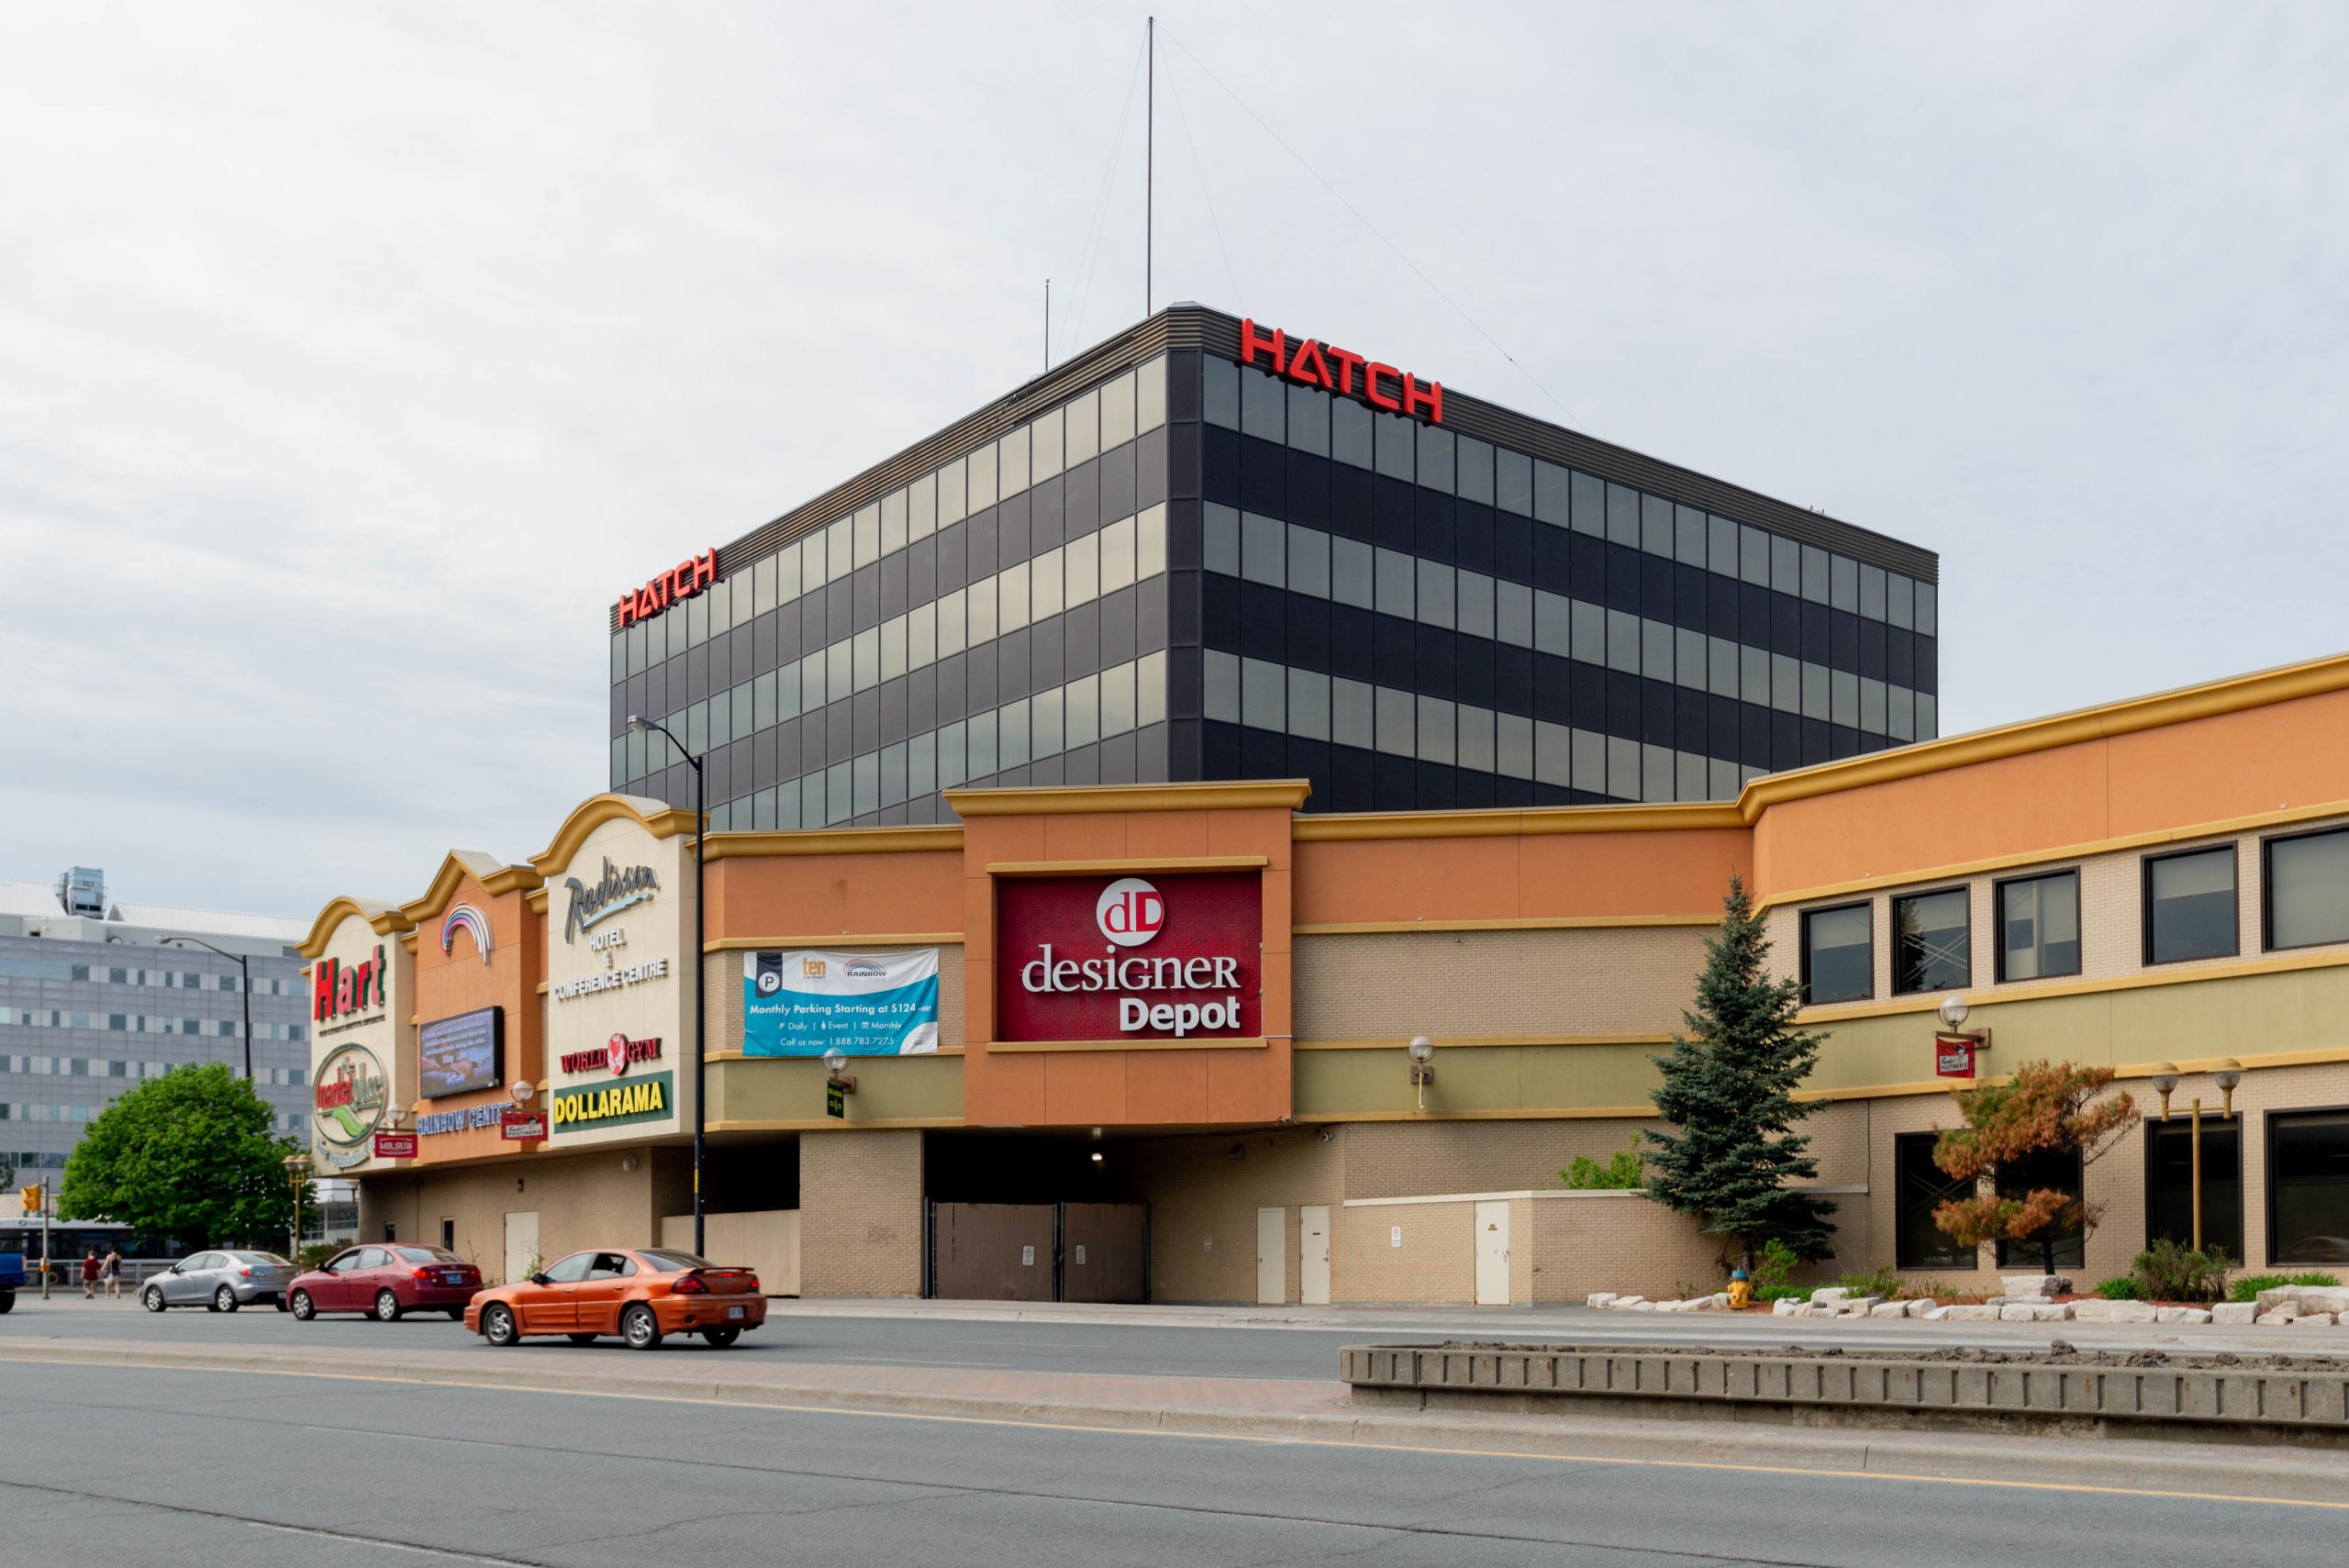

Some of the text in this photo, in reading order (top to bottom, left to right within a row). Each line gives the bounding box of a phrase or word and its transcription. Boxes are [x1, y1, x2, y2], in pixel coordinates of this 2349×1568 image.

[1241, 317, 1442, 424] HATCH
[618, 547, 716, 627] HATCH
[564, 855, 658, 944] Radisson
[590, 929, 627, 952] HOTEL
[314, 944, 385, 1022] Hart
[553, 959, 669, 1001] CONFERENCE CENTRE
[803, 957, 826, 975] ten
[750, 1003, 790, 1017] Monthly
[794, 1003, 831, 1016] Parking
[834, 1003, 875, 1016] Starting
[877, 1005, 888, 1014] at
[891, 1002, 916, 1014] $124
[788, 1020, 902, 1032] Daily Event Monthly
[1120, 995, 1241, 1037] Depot
[561, 1038, 662, 1074] WORLD GYM
[780, 1038, 796, 1046] Call
[829, 1037, 895, 1046] 1.888.783.7275
[417, 1108, 466, 1136] RAINBOW
[553, 1081, 663, 1124] DOLLARAMA
